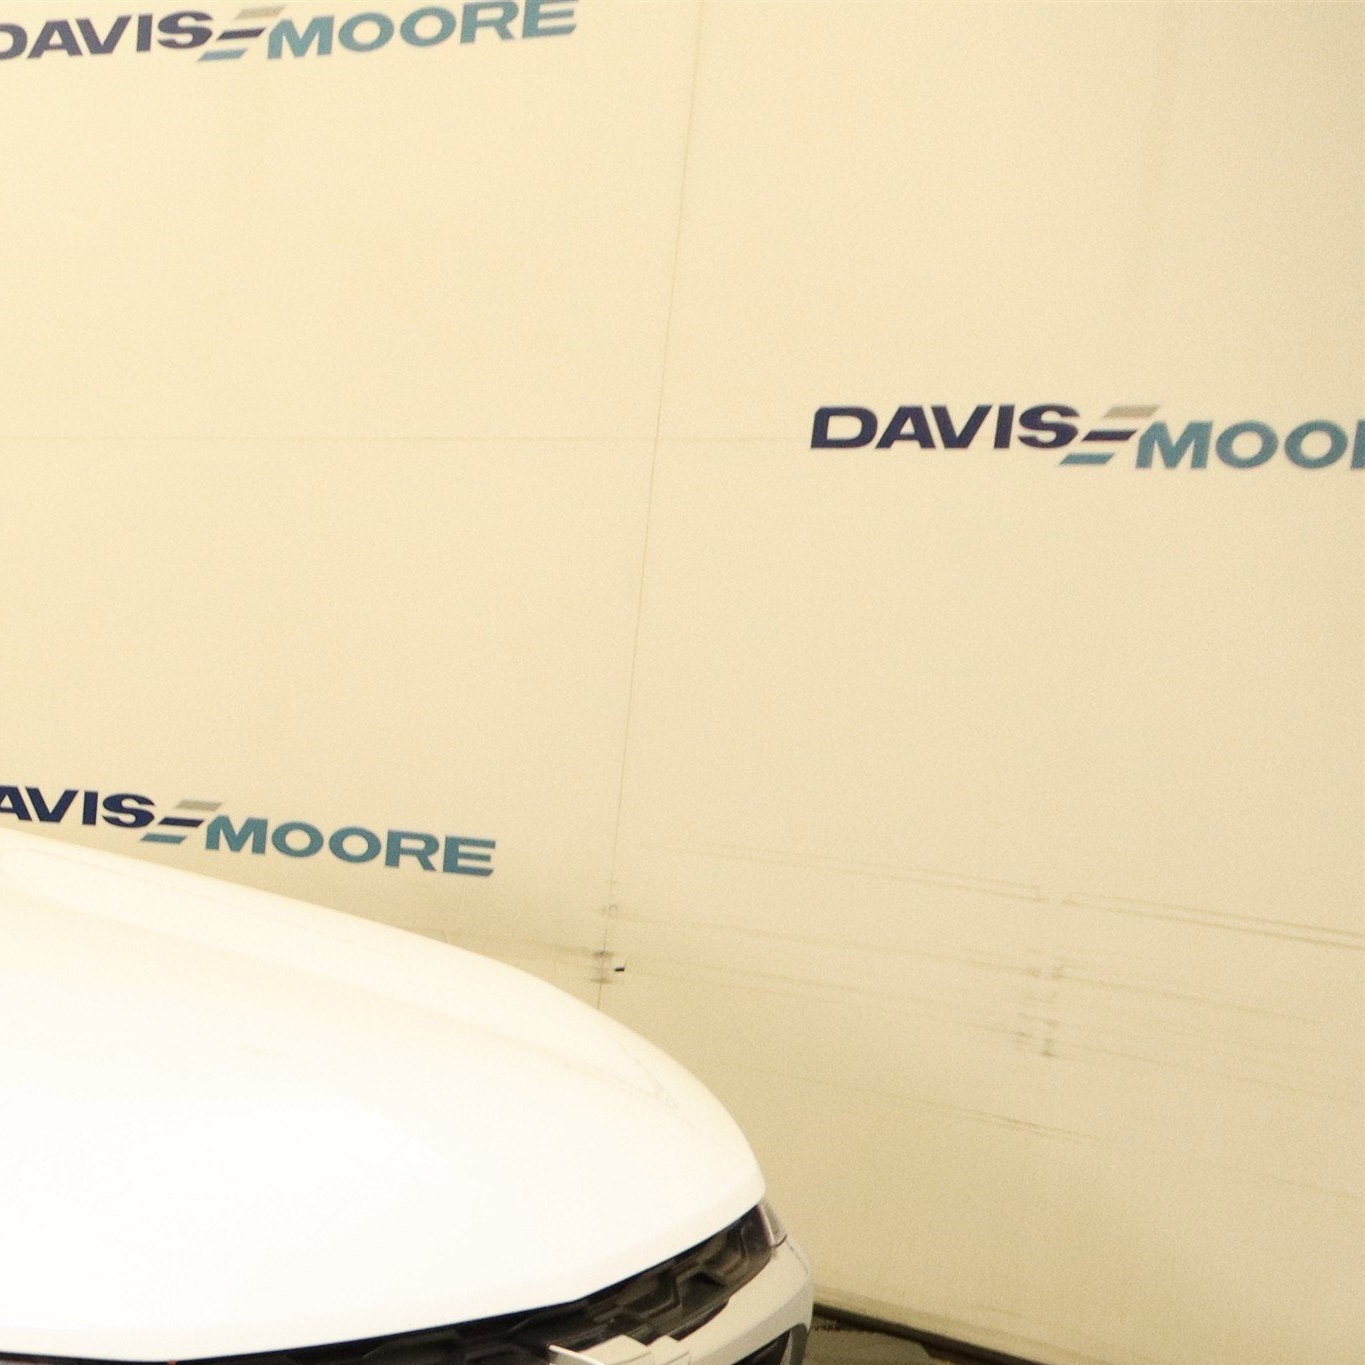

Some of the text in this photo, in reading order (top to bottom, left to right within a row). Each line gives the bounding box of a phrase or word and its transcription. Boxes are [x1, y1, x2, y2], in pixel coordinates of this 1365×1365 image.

[267, 0, 577, 59] MOORE
[810, 404, 1365, 470] DAVIS MOO
[205, 816, 496, 878] MOORE
